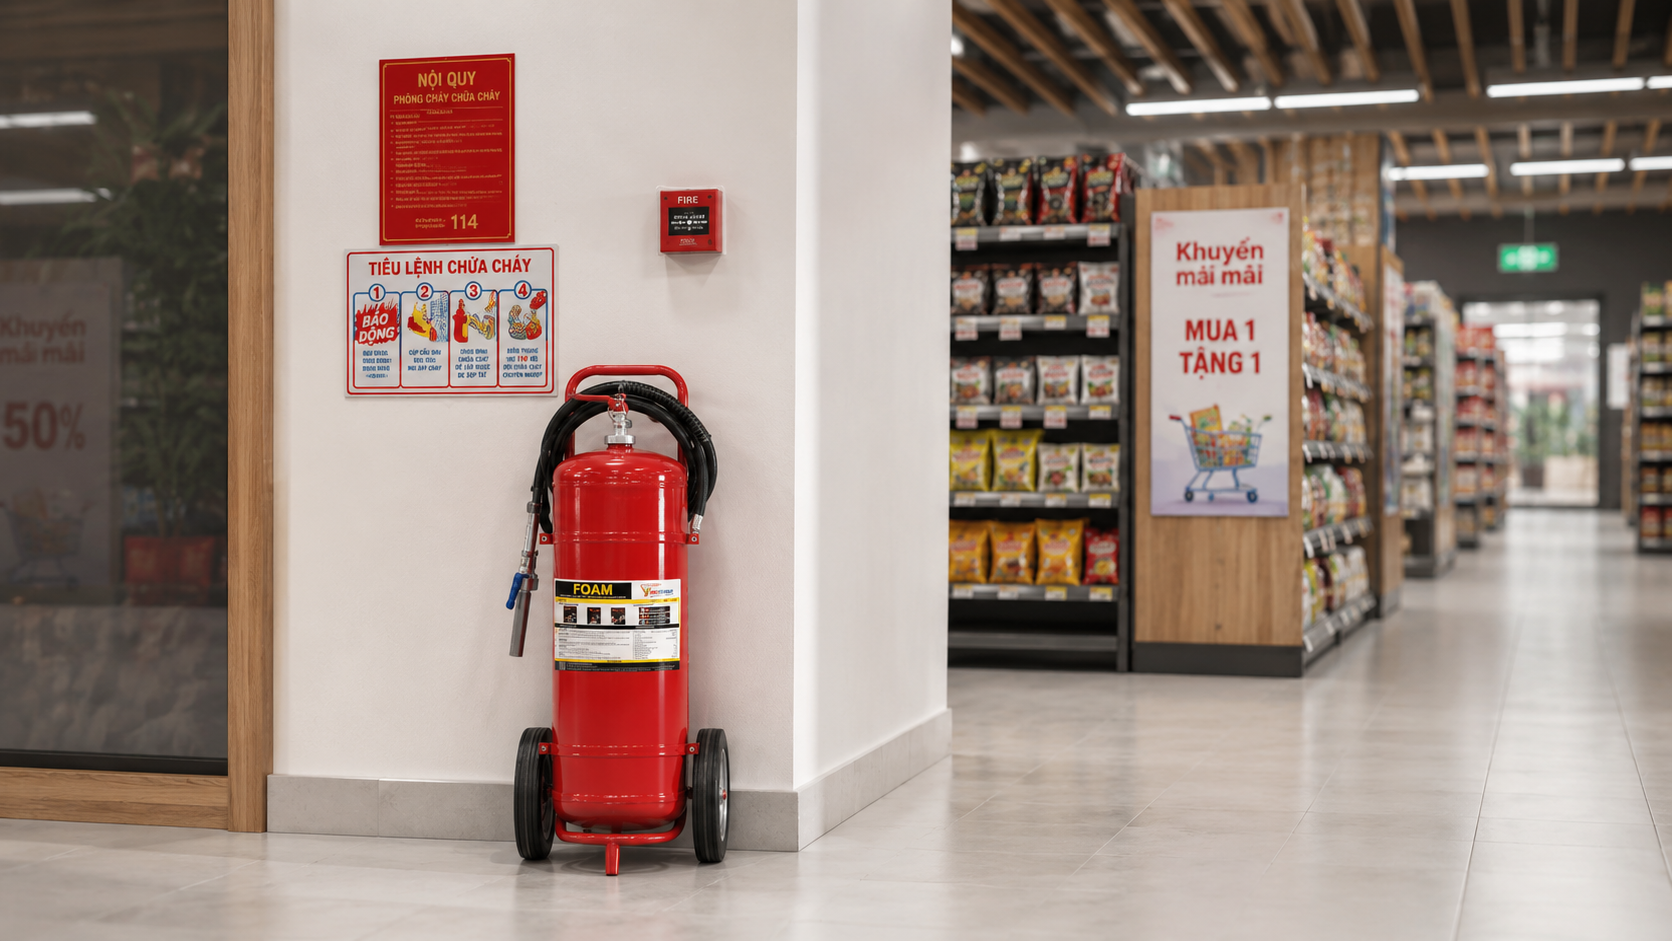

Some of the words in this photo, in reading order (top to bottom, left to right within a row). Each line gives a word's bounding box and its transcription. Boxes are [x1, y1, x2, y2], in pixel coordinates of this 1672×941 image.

[418, 69, 442, 91] NỘI
[447, 71, 477, 89] QUY
[677, 195, 699, 205] FIRE
[450, 213, 479, 230] 114
[368, 257, 401, 276] TIÊU
[405, 256, 443, 278] LỆNH
[492, 254, 532, 273] CHÁY
[372, 286, 381, 299] 1
[420, 285, 430, 298] 2
[469, 284, 479, 297] 3
[517, 283, 528, 297] 4
[362, 310, 389, 328] BÁO
[1185, 319, 1238, 341] MUA
[1245, 319, 1255, 341] 1
[1251, 351, 1261, 374] 1
[3, 401, 86, 450] 50%
[573, 583, 613, 596] FOAM
